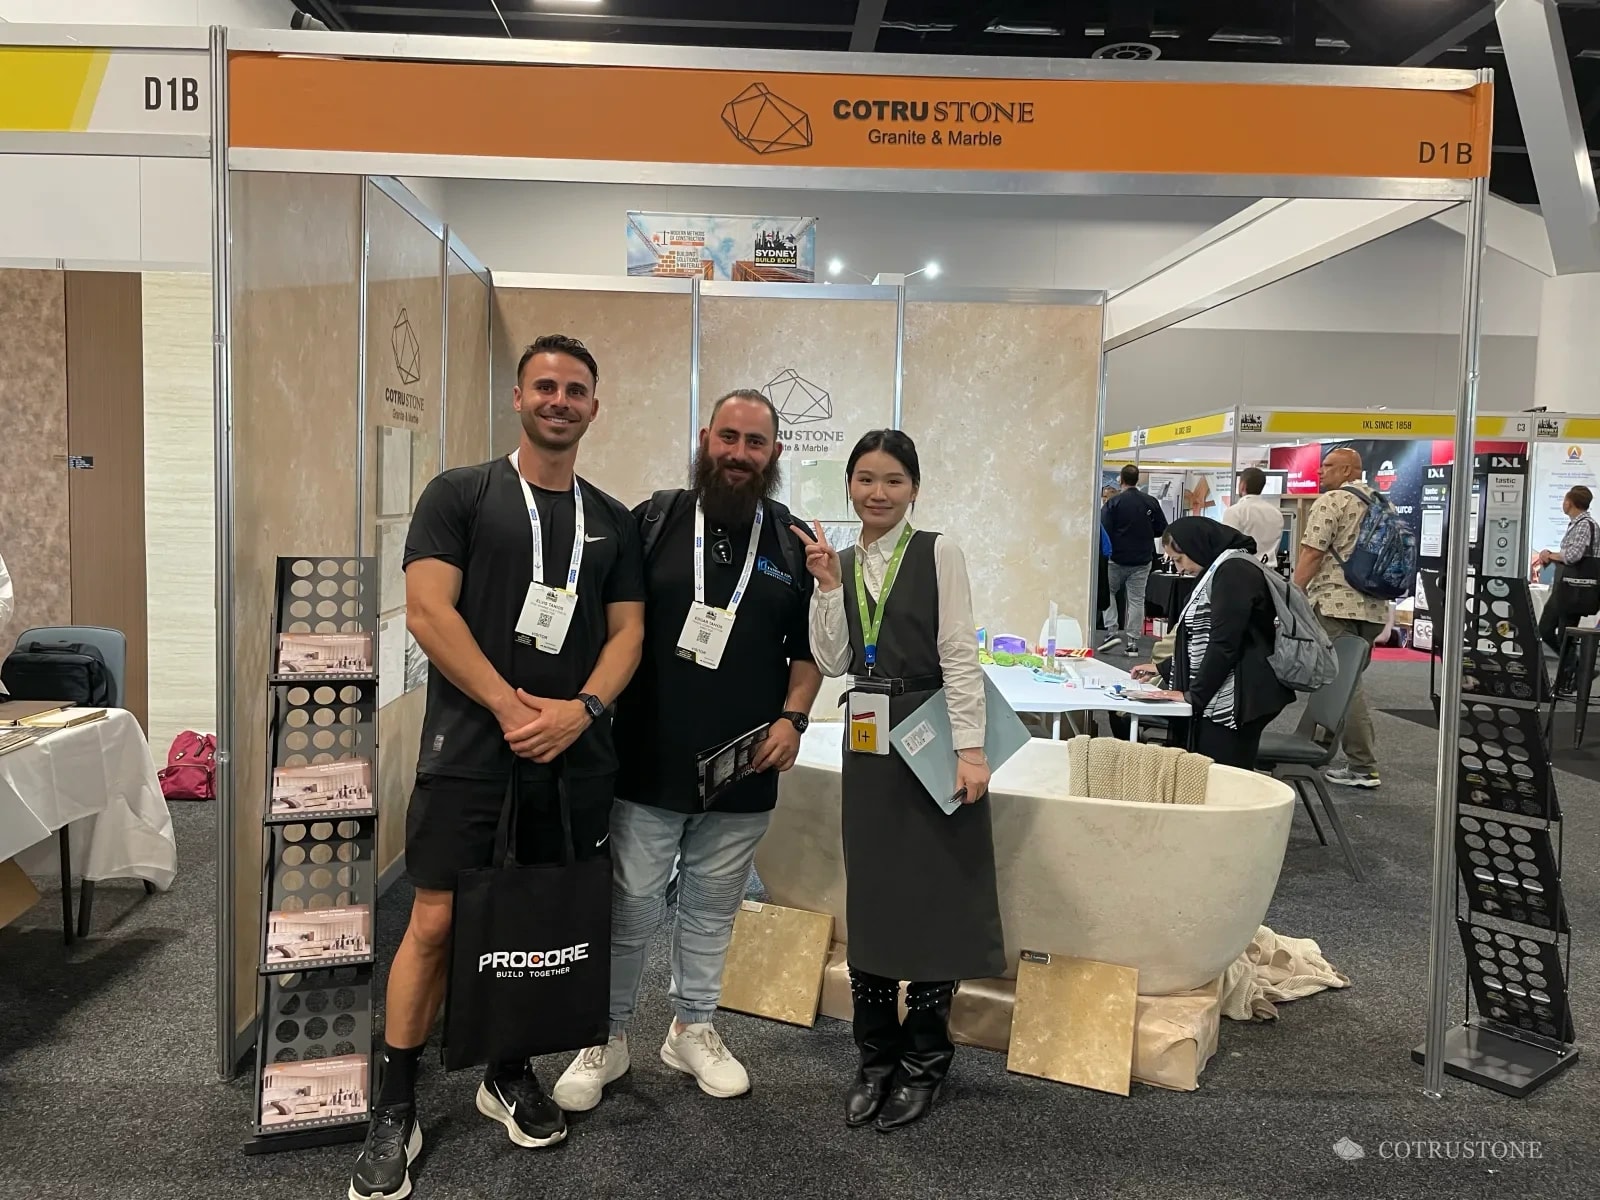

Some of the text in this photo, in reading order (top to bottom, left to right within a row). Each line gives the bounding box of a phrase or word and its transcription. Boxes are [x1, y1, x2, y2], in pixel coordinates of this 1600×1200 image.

[144, 76, 199, 111] D1B
[868, 129, 1002, 147] Granite & Marble
[1419, 141, 1473, 165] D1B
[755, 249, 796, 258] SYDNEY
[1362, 420, 1412, 430] IXL SINCE 1858
[1517, 423, 1526, 432] C3
[802, 444, 829, 452] Marble
[1491, 456, 1521, 468] IXL
[1427, 468, 1445, 479] IXL
[478, 942, 590, 973] PROCORE
[528, 966, 571, 978] TOGETHER
